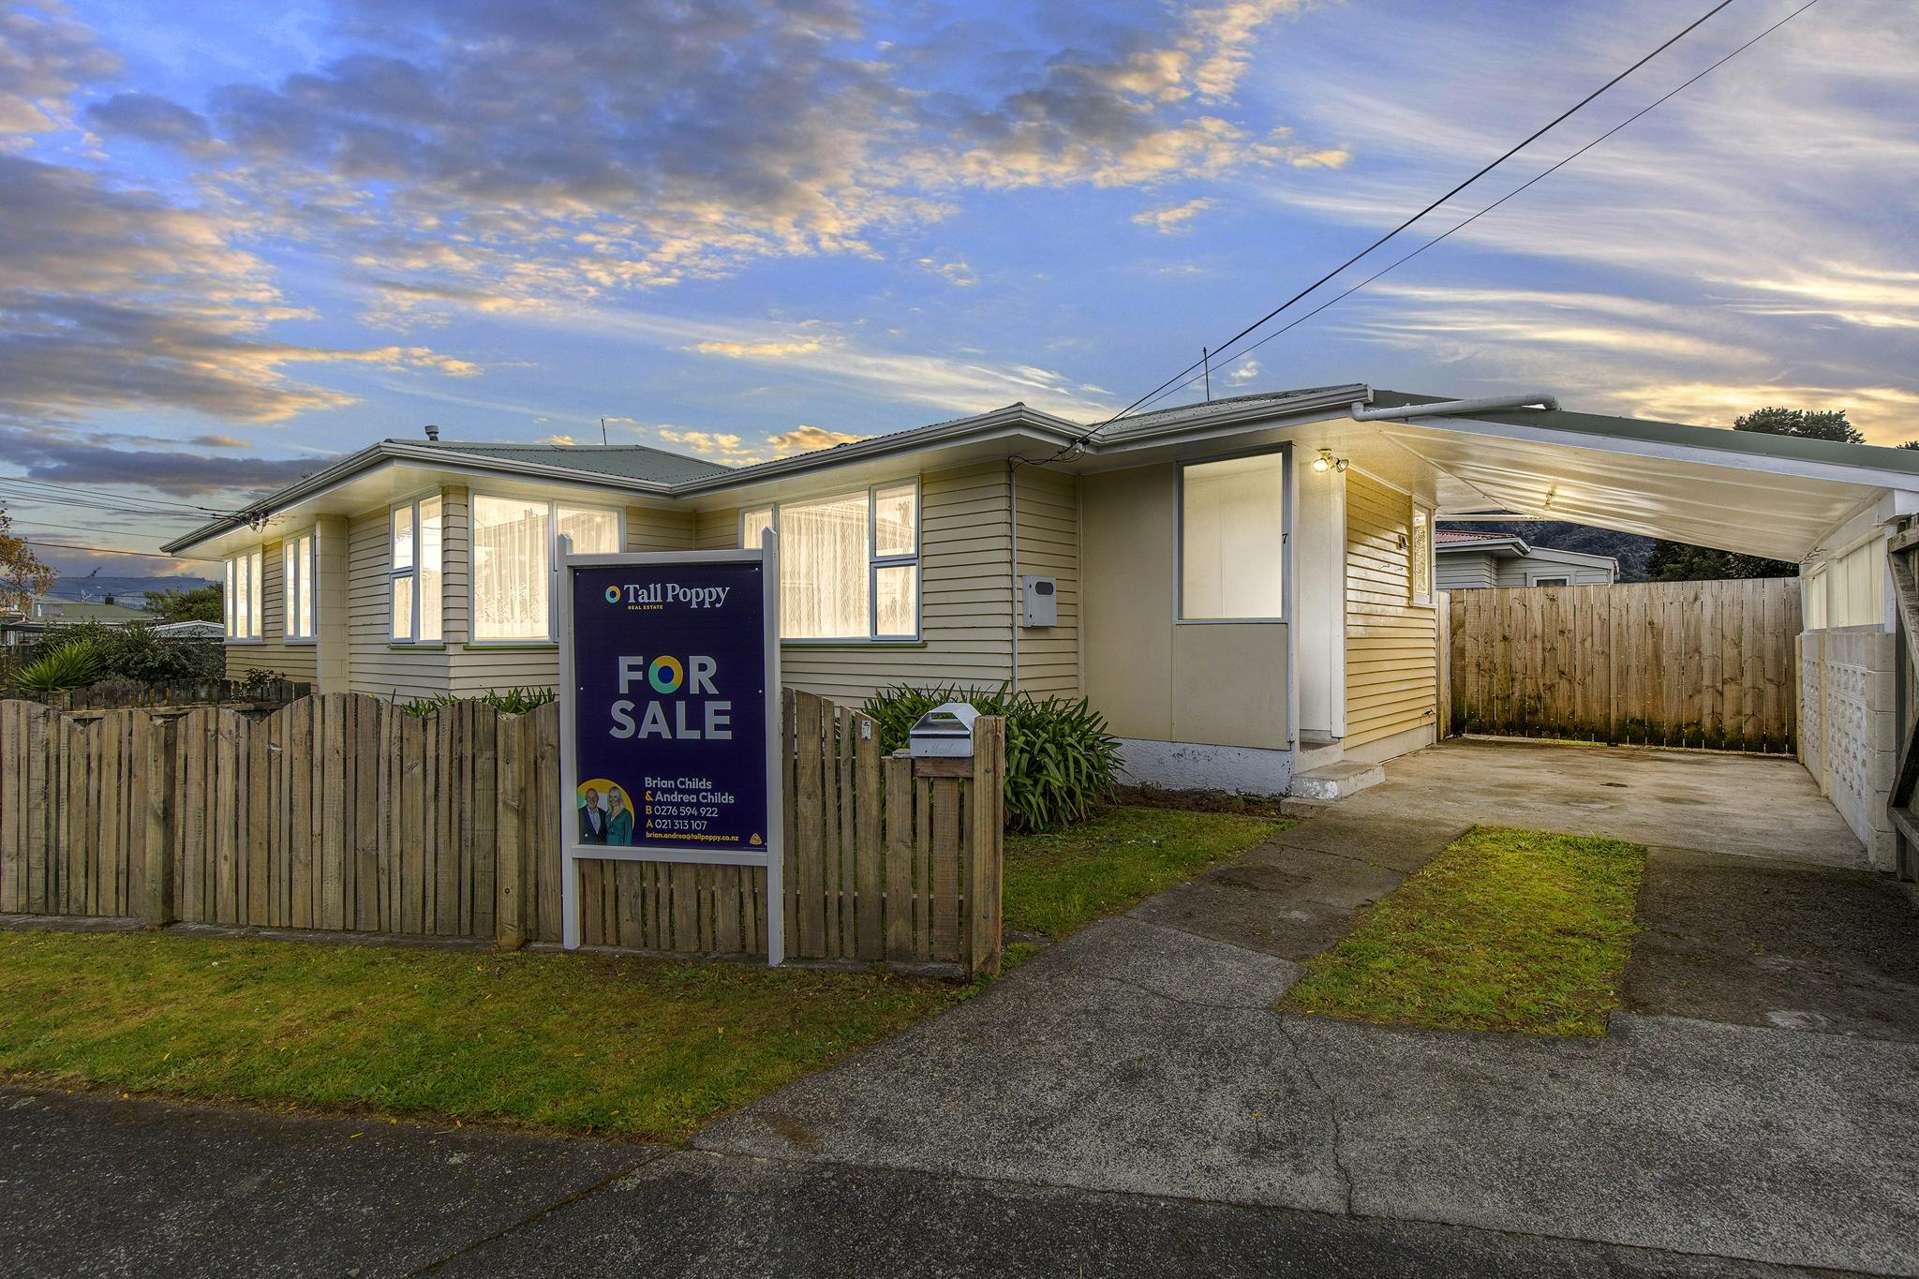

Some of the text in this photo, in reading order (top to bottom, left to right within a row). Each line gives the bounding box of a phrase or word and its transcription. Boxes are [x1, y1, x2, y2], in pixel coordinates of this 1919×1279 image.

[624, 583, 730, 608] Tall Poppy
[618, 655, 718, 694] FOR
[609, 700, 732, 740] SALE
[645, 777, 712, 789] Brian Childs
[645, 791, 735, 805] & Andrea Childs
[646, 806, 719, 817] B 0276 594 922
[646, 820, 707, 831] A 021 313 107
